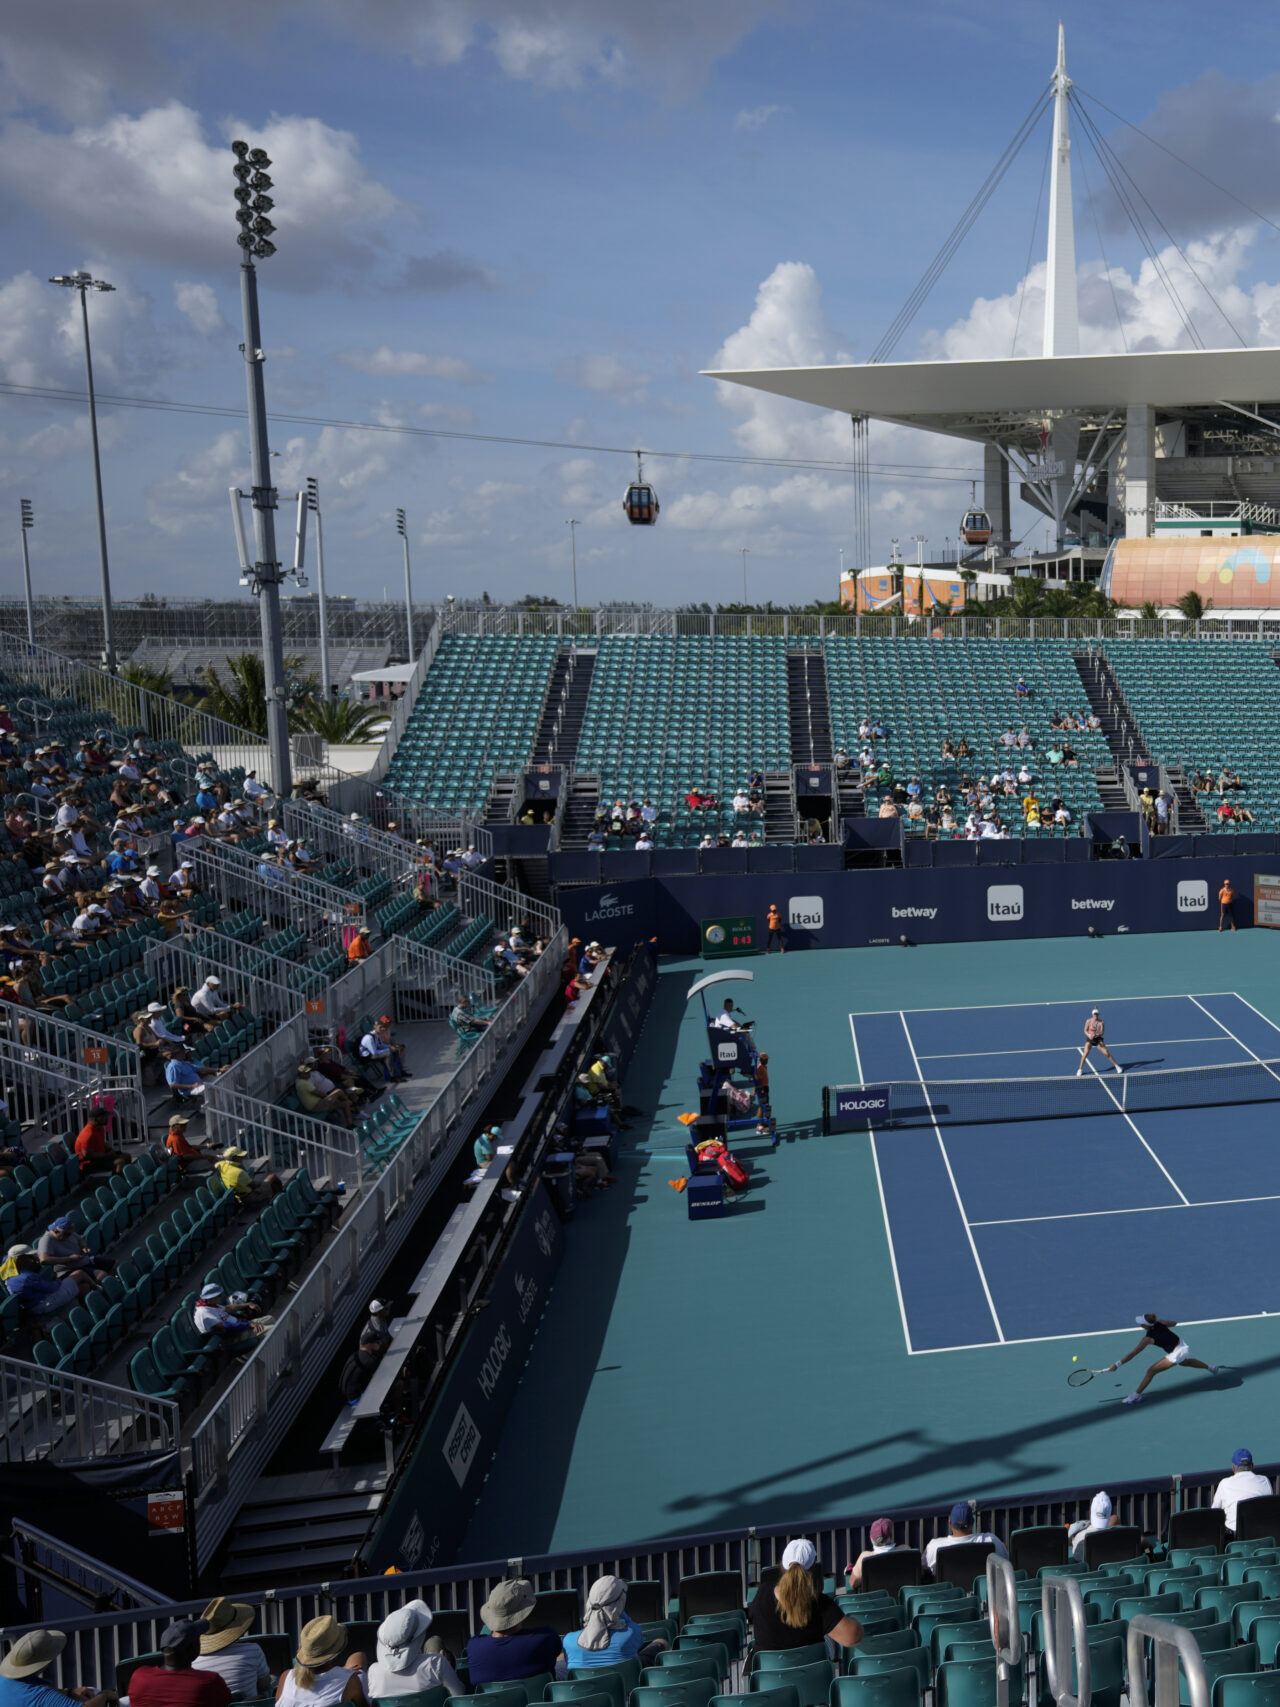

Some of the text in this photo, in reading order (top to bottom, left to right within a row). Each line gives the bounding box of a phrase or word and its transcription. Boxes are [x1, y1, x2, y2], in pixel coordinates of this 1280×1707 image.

[1071, 898, 1115, 912] betway
[1180, 893, 1206, 907] Itaú
[585, 903, 634, 922] LACOSTE
[891, 906, 938, 919] betway
[990, 900, 1021, 916] Itaú
[791, 911, 821, 925] Itaú
[840, 1099, 886, 1111] HOLOGIC
[690, 1200, 722, 1208] DUNLOP
[518, 1277, 538, 1325] LACOSTE
[477, 1323, 512, 1400] HOLOGIC
[448, 1412, 467, 1464] ASSIST
[460, 1423, 476, 1464] CARD
